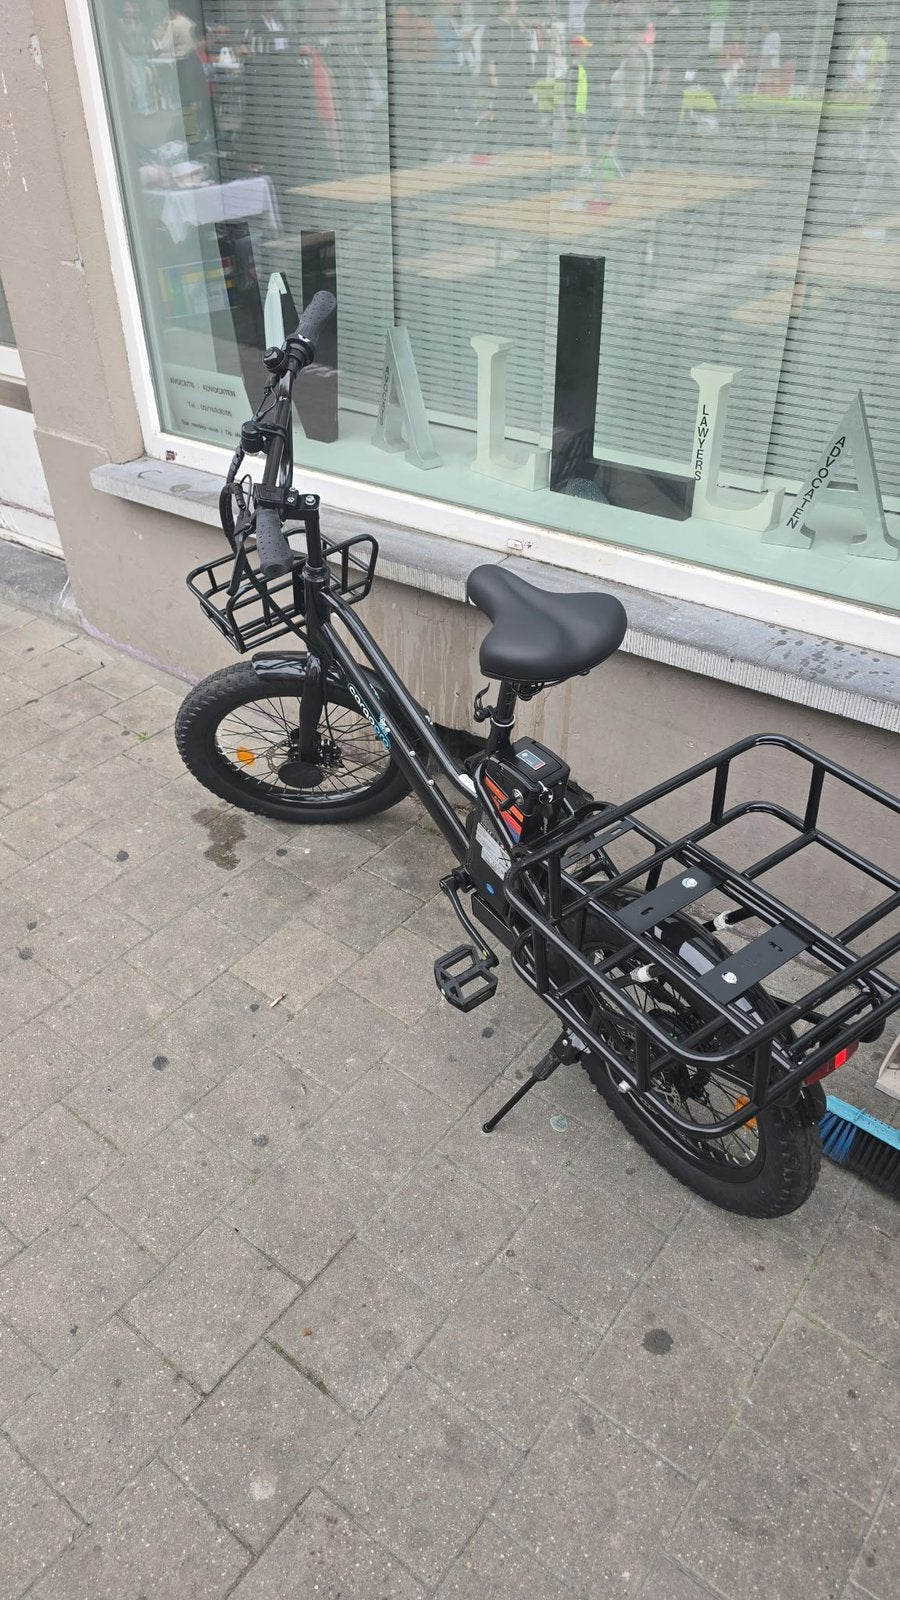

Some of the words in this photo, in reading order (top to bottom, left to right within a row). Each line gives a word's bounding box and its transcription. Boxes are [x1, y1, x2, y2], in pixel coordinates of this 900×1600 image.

[202, 384, 236, 397] ADVOCATEN
[694, 404, 709, 481] LAWYERS
[786, 435, 846, 529] ADVOCATEN
